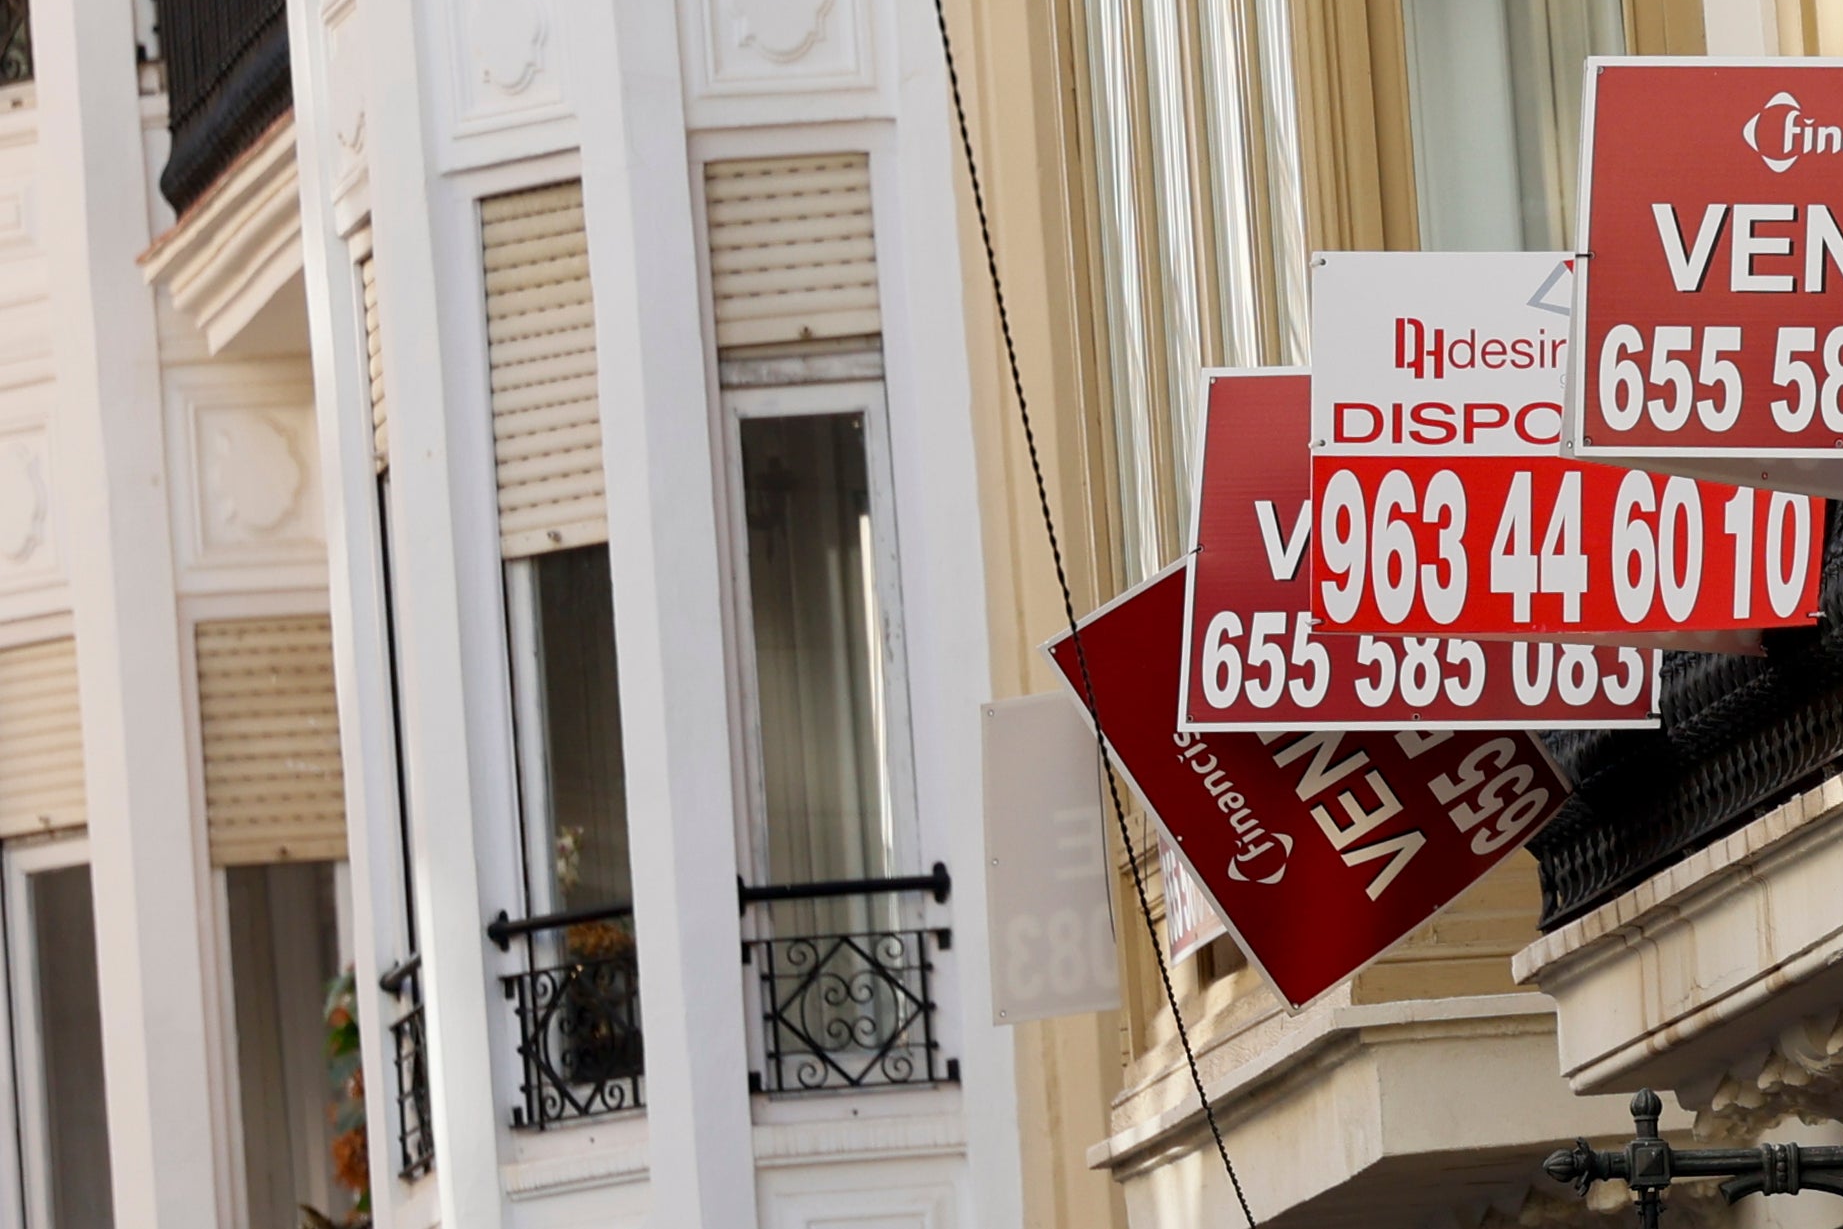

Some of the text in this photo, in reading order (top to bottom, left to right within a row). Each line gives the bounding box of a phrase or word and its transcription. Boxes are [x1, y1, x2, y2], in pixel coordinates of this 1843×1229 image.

[1598, 323, 1743, 432] 655
[1320, 468, 1810, 625] 963 44 60 10
[1202, 610, 1331, 709] 655
[1354, 634, 1486, 709] 585
[1427, 736, 1550, 856] 655
